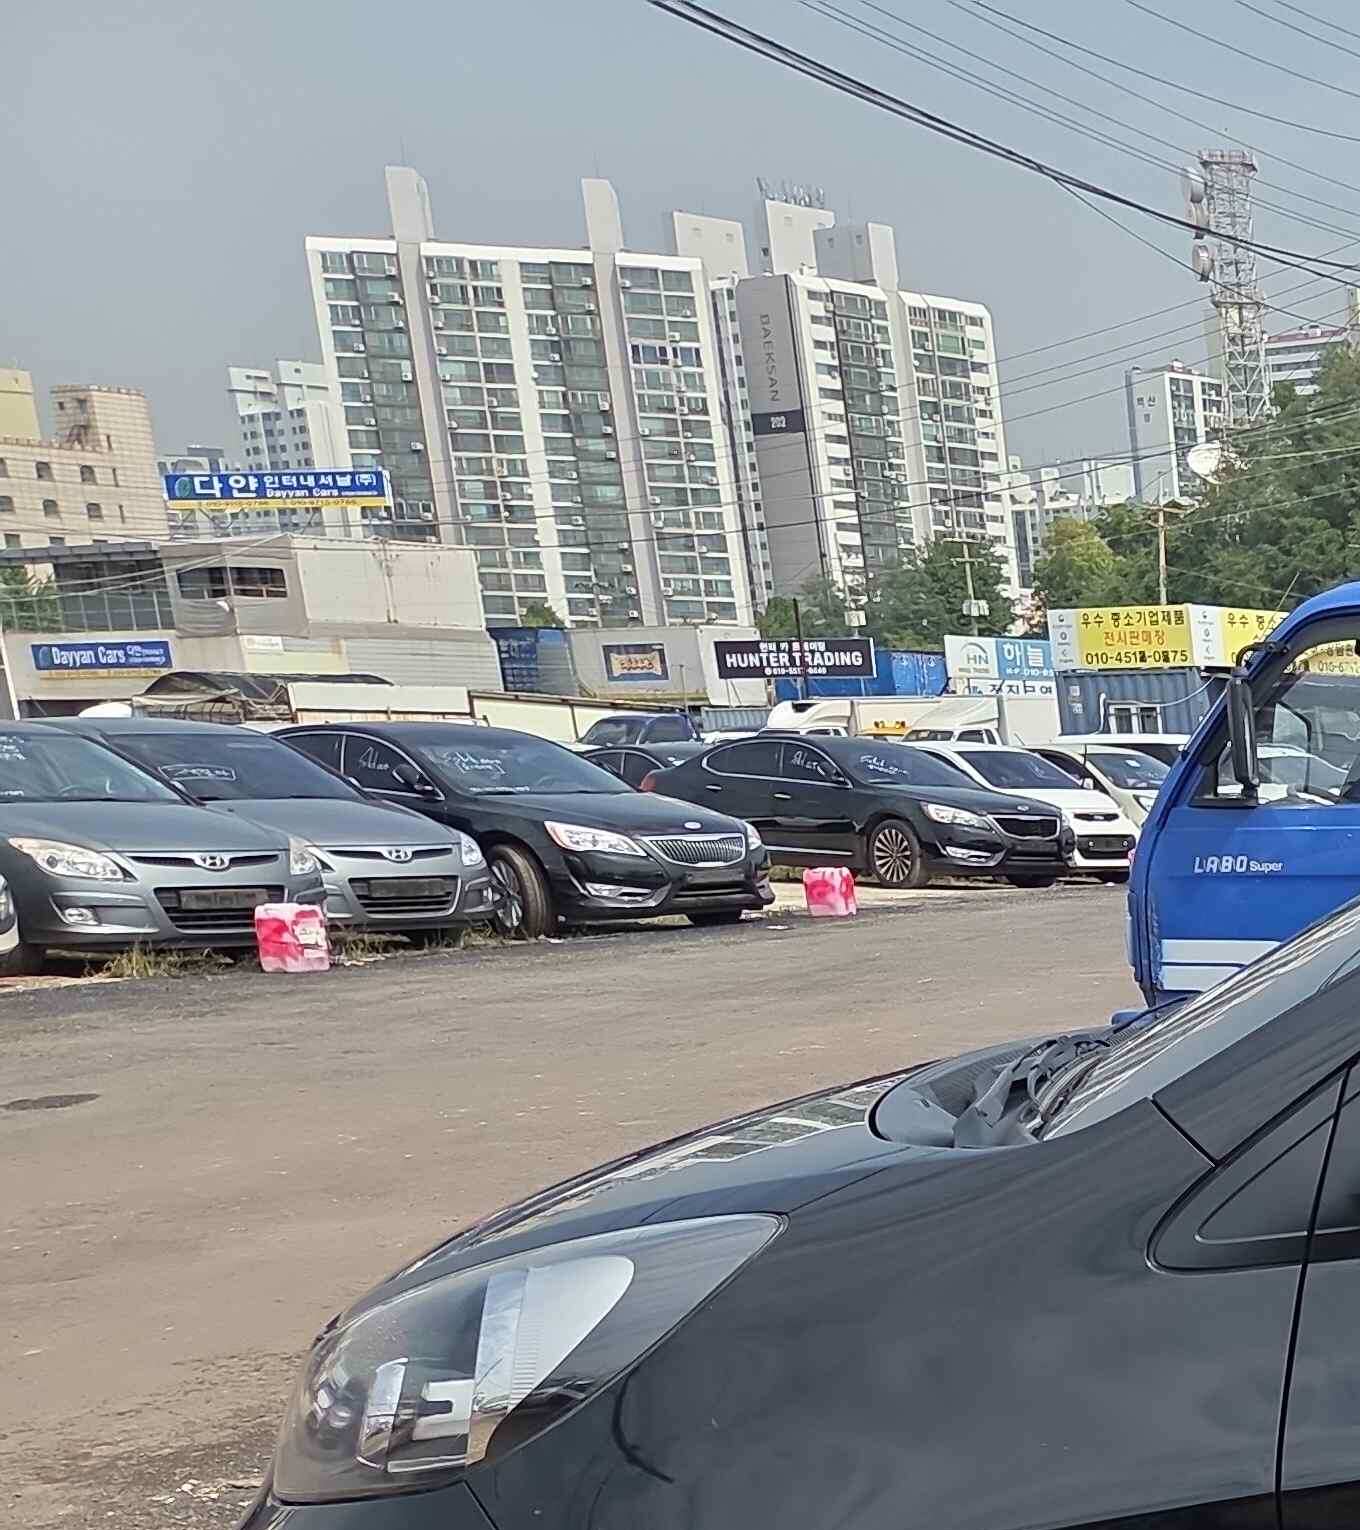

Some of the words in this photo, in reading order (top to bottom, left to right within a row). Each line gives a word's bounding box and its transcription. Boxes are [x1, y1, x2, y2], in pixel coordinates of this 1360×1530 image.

[267, 488, 309, 498] Dayyan
[312, 487, 339, 497] Cars
[1081, 612, 1104, 628] 우수
[1227, 612, 1249, 628] 우수
[52, 646, 96, 668] Dayyan
[98, 646, 126, 664] Cars
[725, 652, 790, 668] HUNTER
[792, 651, 863, 666] TRADING
[967, 654, 989, 665] HN
[1002, 642, 1045, 668] 하늘
[1193, 855, 1248, 873] LABO
[1249, 860, 1283, 874] Super
